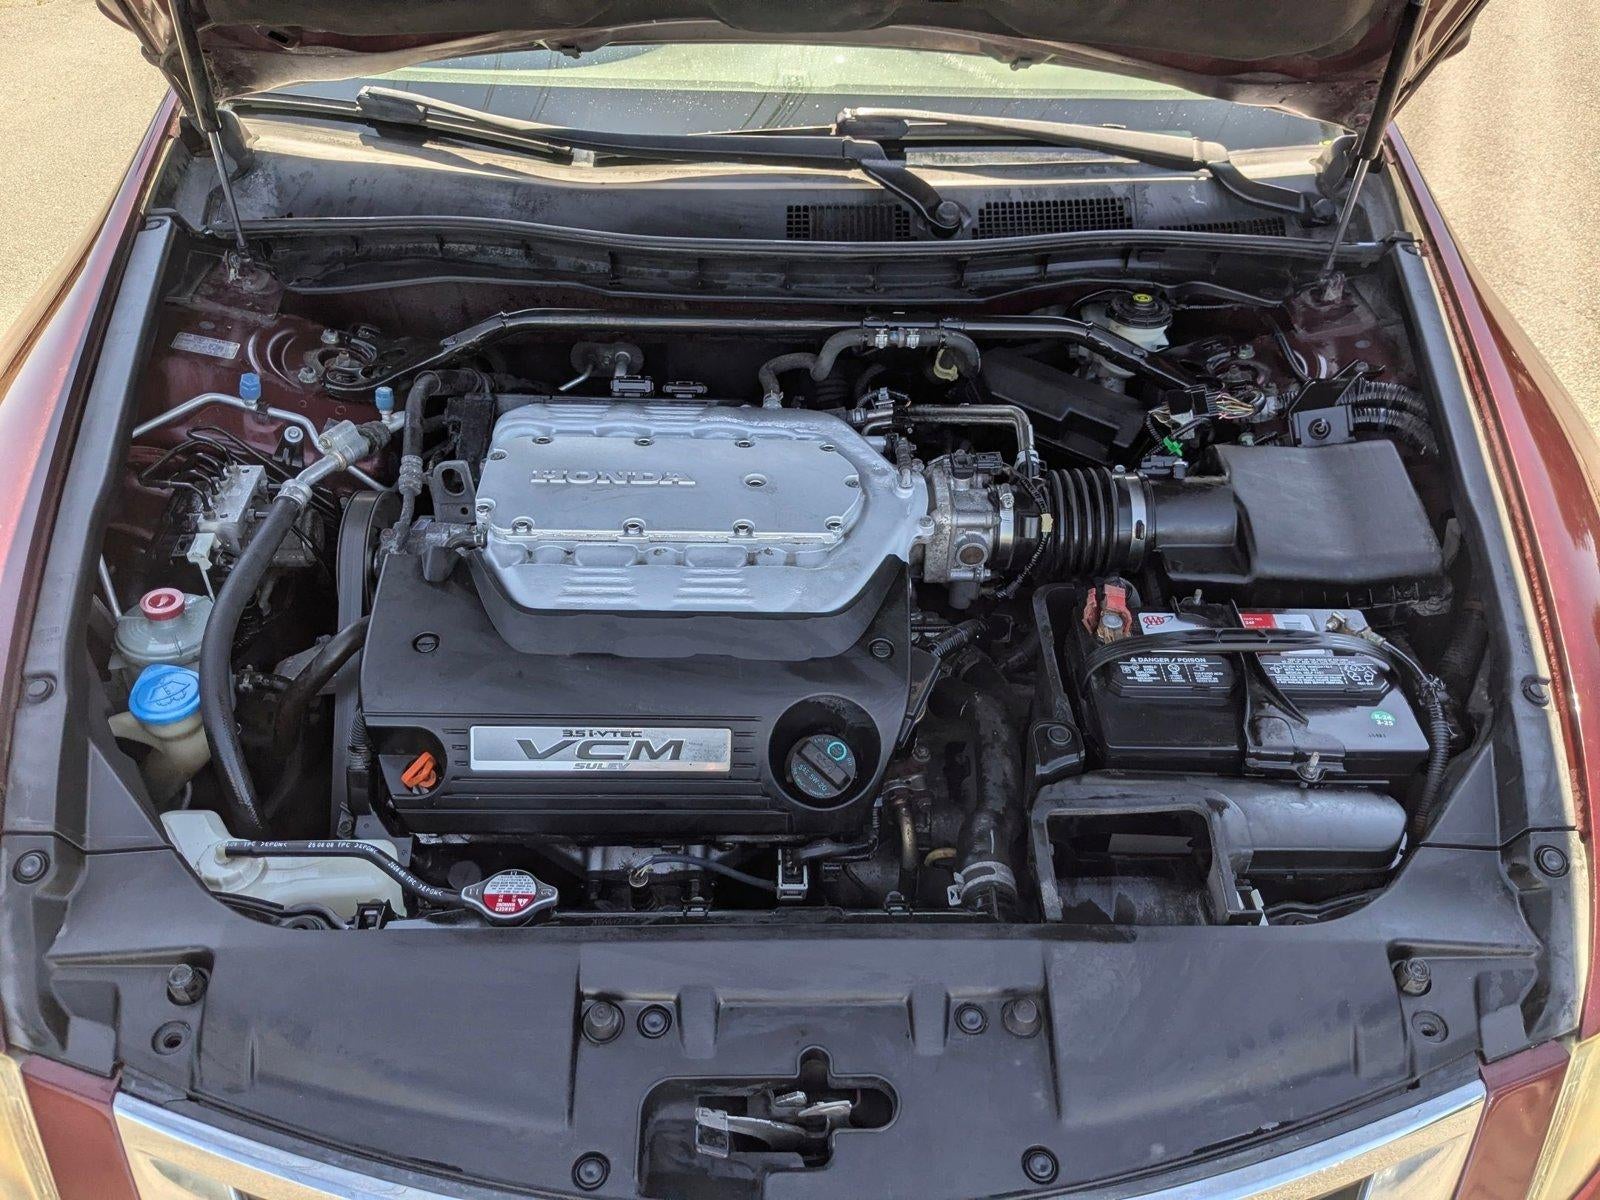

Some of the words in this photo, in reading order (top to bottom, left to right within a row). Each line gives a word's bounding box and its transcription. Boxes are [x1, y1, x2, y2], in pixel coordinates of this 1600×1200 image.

[530, 469, 696, 485] HONDA
[562, 729, 587, 738] 3.5
[514, 738, 685, 761] VCM
[573, 762, 632, 770] SULEV
